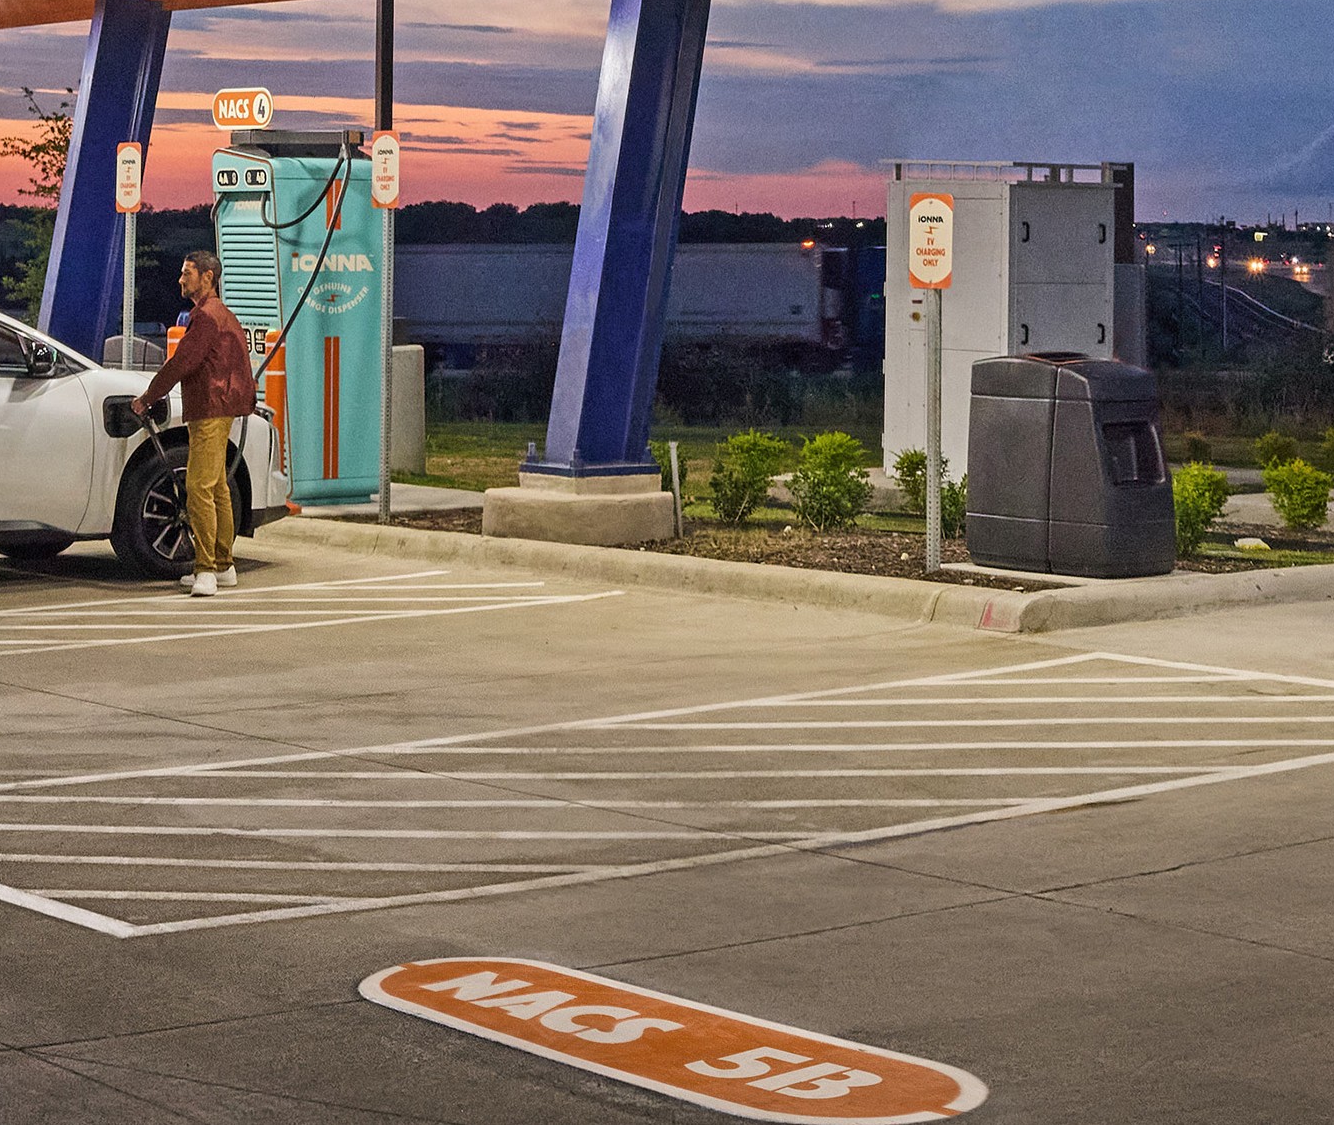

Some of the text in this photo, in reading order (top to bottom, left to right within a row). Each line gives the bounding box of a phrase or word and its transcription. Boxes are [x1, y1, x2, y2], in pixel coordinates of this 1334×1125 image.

[218, 98, 266, 119] NACS 4
[218, 172, 229, 184] 4A
[297, 286, 326, 313] CARGE
[420, 970, 883, 1100] NACS 5B
